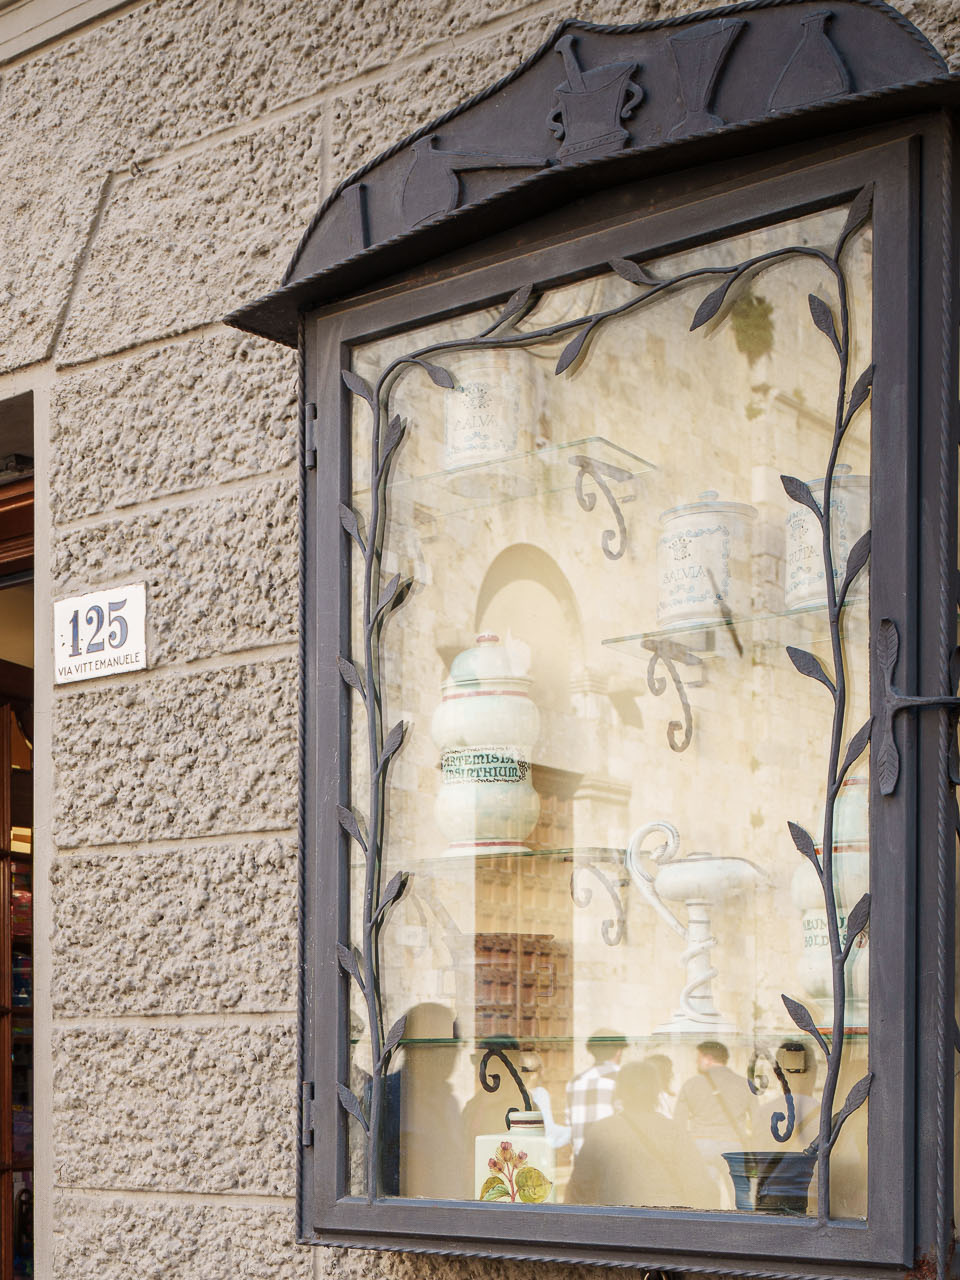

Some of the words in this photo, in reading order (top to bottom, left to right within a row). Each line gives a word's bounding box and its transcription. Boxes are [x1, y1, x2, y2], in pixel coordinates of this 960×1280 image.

[663, 565, 707, 584] SALVIA
[68, 598, 128, 658] 125
[58, 665, 73, 677] VIA
[95, 651, 141, 671] EMANUELE
[443, 753, 515, 768] ARTEMISIA
